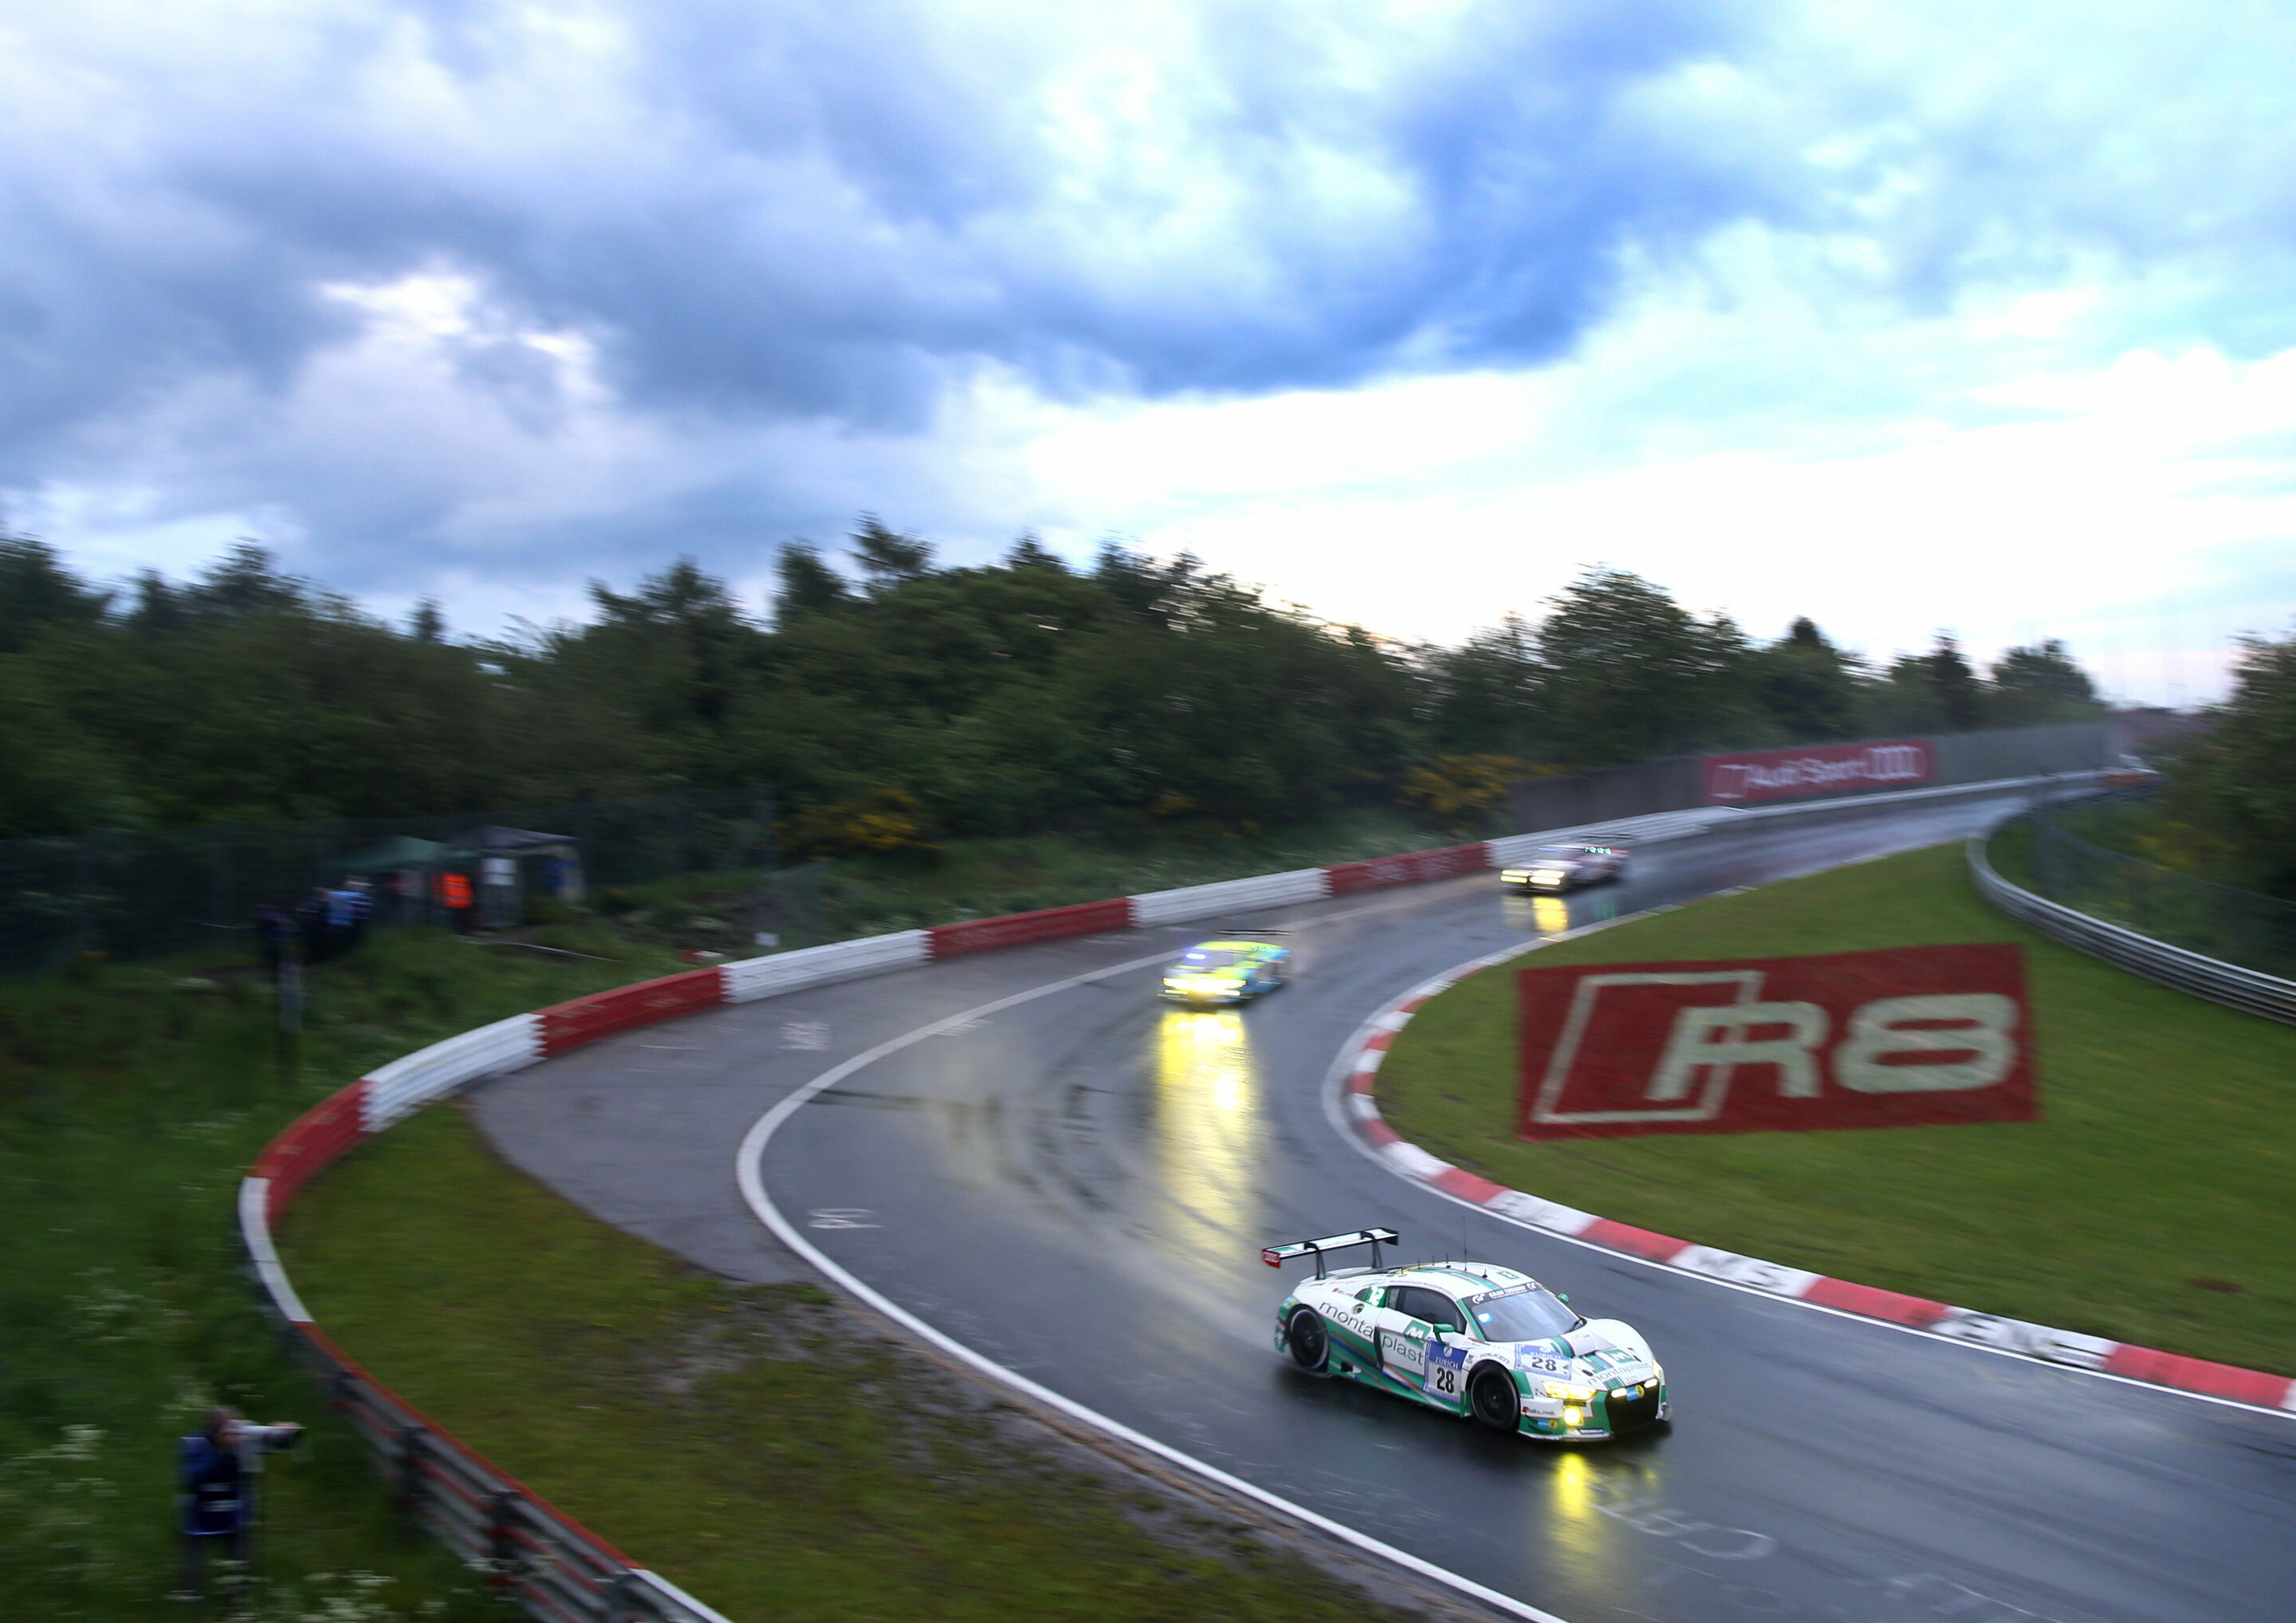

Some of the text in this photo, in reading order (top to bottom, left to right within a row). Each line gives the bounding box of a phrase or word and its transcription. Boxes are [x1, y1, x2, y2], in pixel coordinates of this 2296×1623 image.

[1645, 992, 2020, 1102] R8
[1319, 1301, 1374, 1338] monta
[1382, 1334, 1424, 1366] plast
[1435, 1356, 1459, 1370] ZURICH
[1531, 1357, 1557, 1371] 28
[1437, 1366, 1455, 1393] 28
